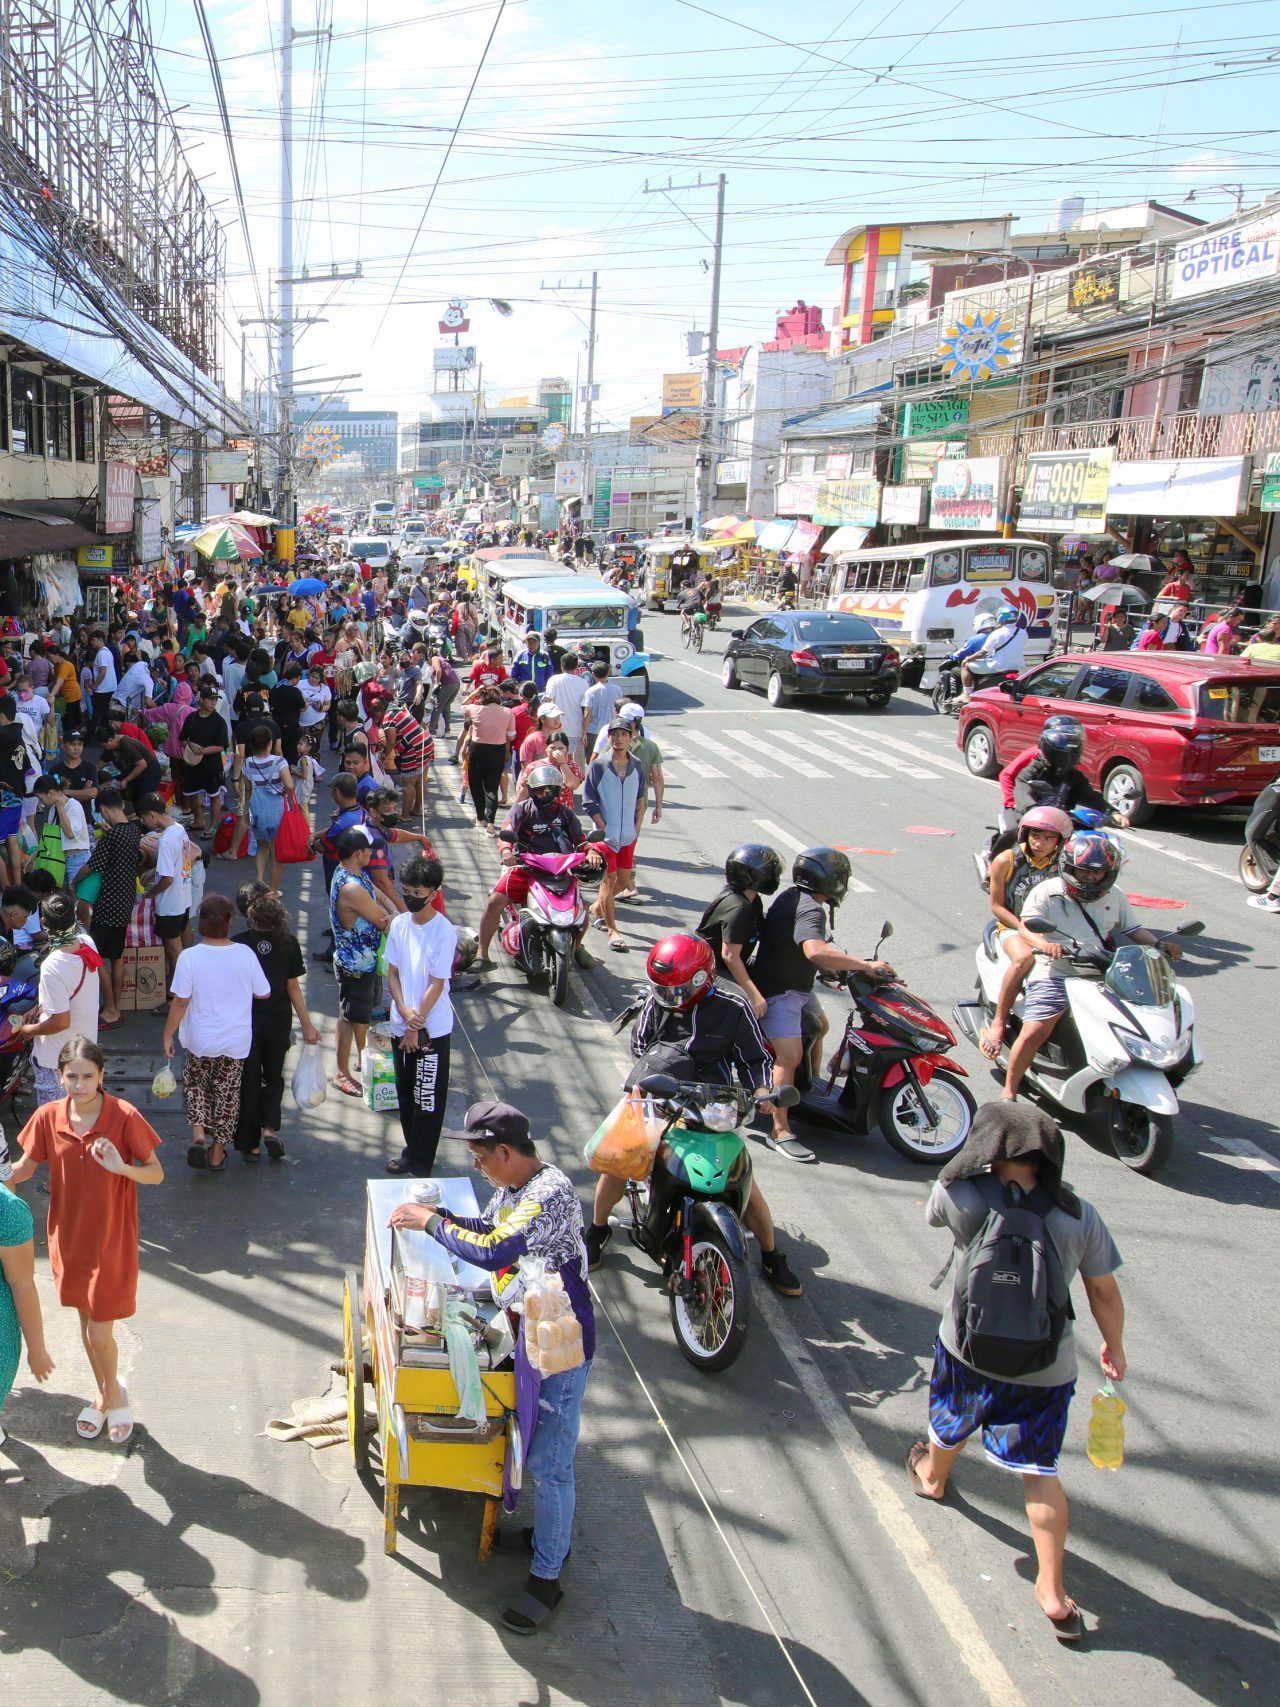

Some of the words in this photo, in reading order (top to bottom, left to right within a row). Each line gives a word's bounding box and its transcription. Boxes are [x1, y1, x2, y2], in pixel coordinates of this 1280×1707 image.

[1178, 231, 1241, 263] CLAIRE
[1182, 240, 1273, 282] OPTICAL
[911, 400, 967, 413] MASSAGE
[927, 411, 949, 422] SPA
[112, 467, 135, 494] JARO
[1033, 482, 1050, 502] FOR
[1049, 461, 1086, 504] 999
[1260, 750, 1277, 758] NFE
[849, 1029, 867, 1045] HONDA
[416, 1058, 424, 1080] TRACK
[381, 1087, 394, 1096] Go
[420, 1053, 439, 1112] WHITEWATER
[380, 1101, 396, 1109] Bag
